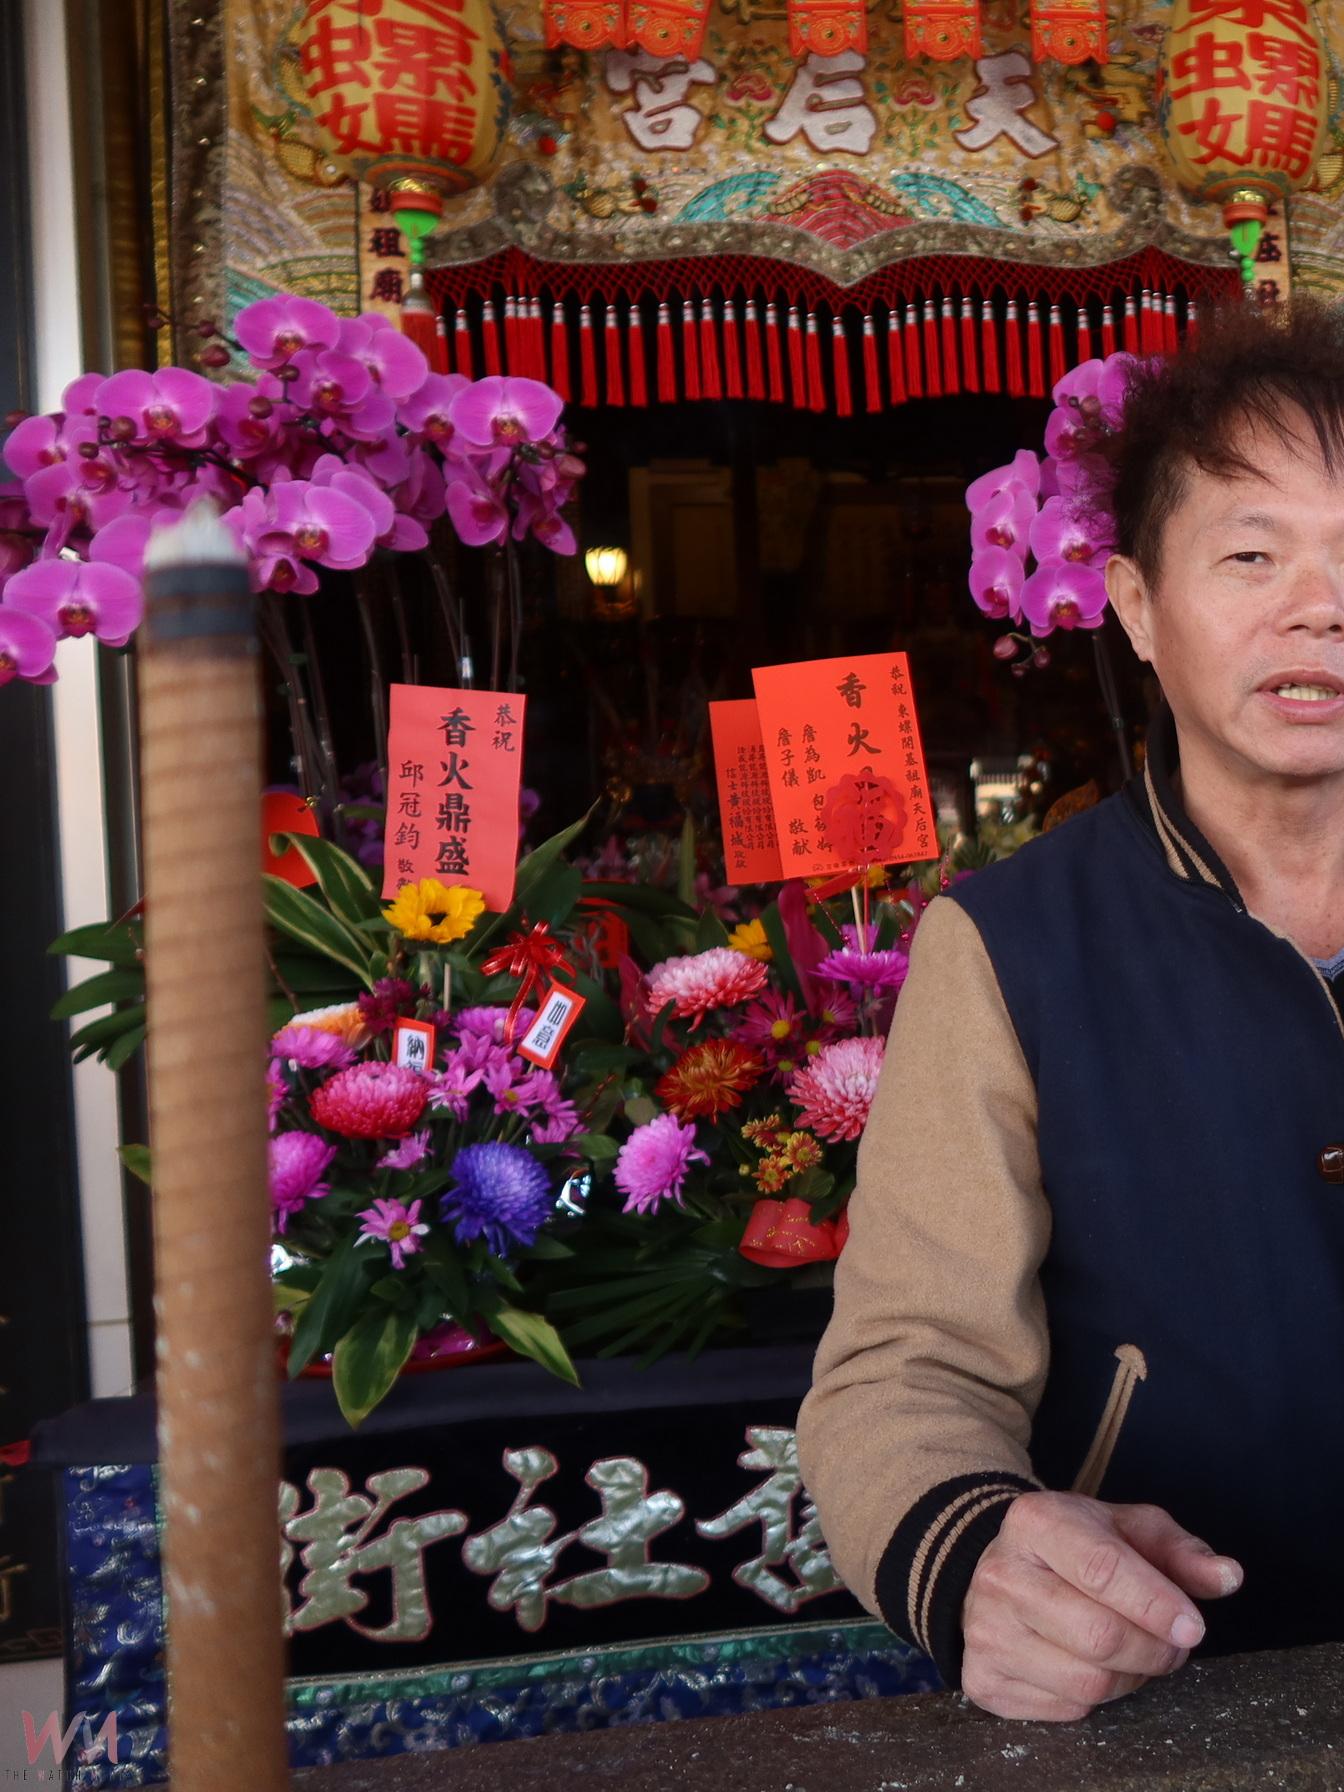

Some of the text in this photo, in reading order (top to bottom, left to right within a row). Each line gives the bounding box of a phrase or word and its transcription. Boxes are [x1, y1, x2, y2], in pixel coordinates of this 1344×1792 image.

[492, 703, 517, 752] 恭祝
[393, 759, 424, 851] 邱冠鈞
[434, 706, 477, 877] 香火鼎盛
